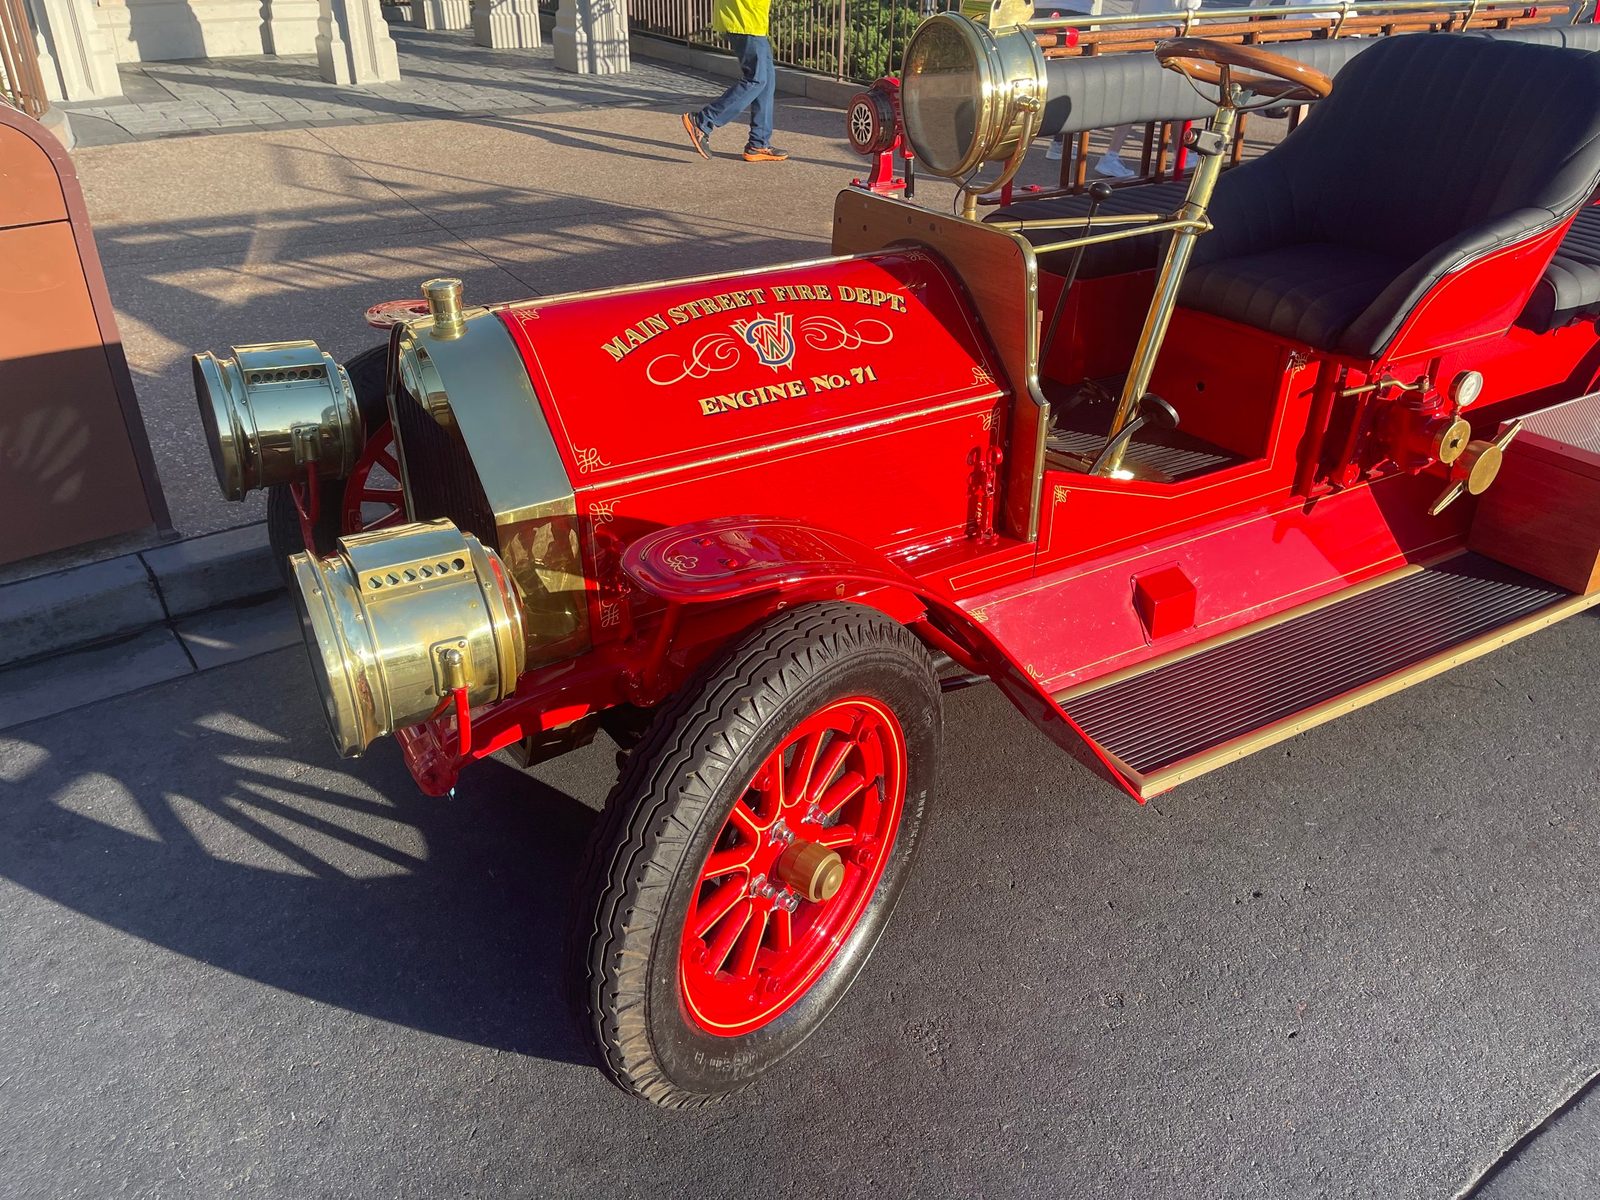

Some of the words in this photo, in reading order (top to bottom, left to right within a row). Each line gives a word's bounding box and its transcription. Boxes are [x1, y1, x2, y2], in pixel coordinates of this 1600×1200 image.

[601, 311, 670, 362] MAIN
[667, 287, 766, 326] STREET
[773, 285, 832, 302] FIRE
[837, 285, 907, 314] DEPT.
[698, 379, 807, 416] ENGINE
[849, 364, 878, 384] 71
